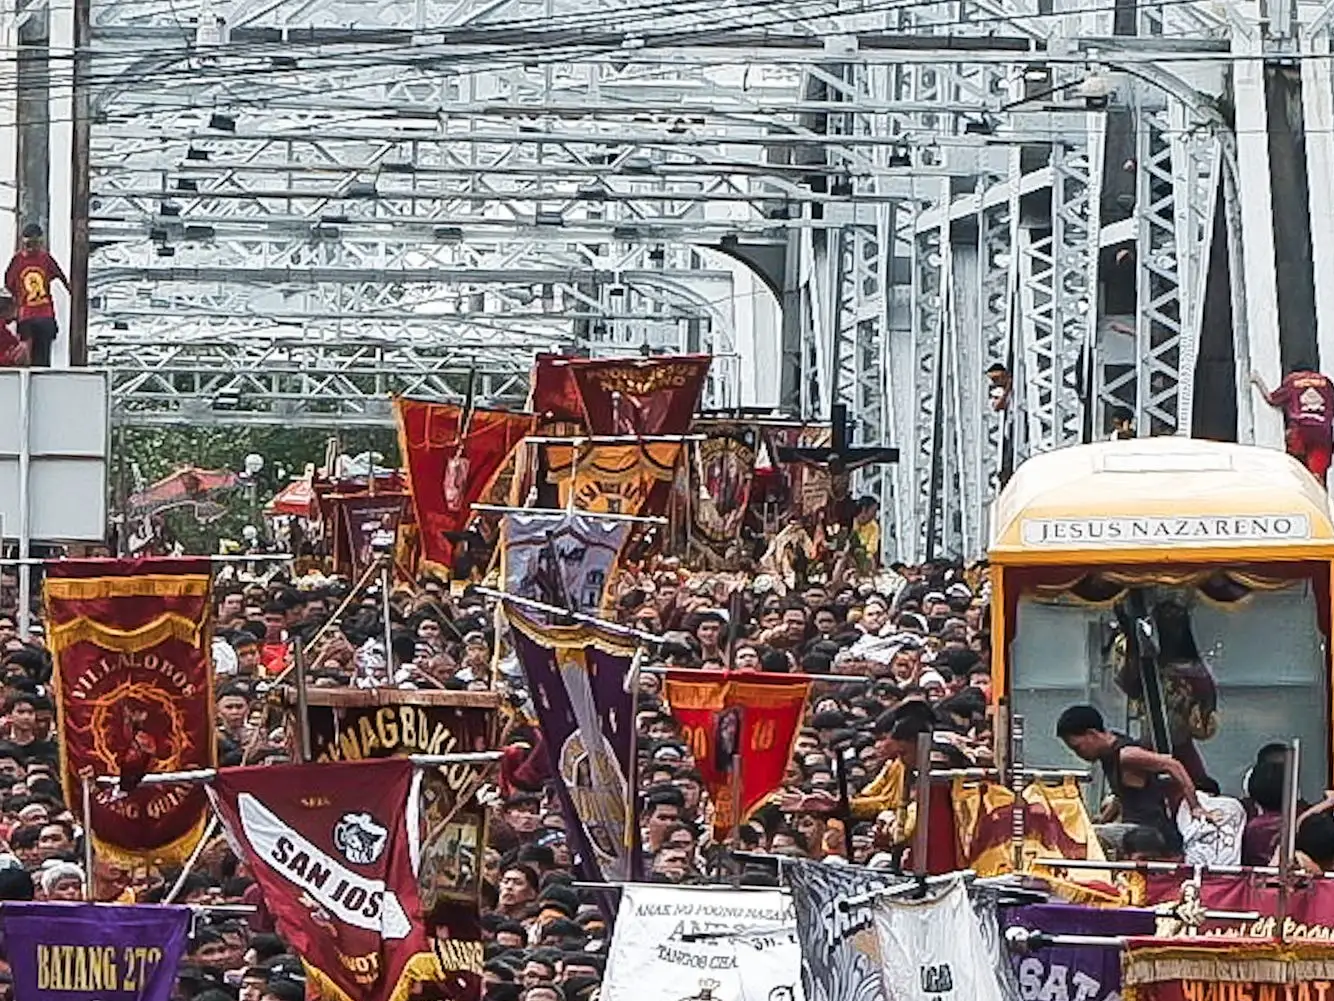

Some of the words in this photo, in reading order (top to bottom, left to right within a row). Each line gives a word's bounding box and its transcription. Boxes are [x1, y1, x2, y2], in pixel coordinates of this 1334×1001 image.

[1041, 520, 1122, 543] JESUS
[1132, 517, 1292, 537] NAZARENO
[271, 836, 332, 891] SAN
[328, 879, 384, 918] JOS
[37, 943, 118, 991] BATANG
